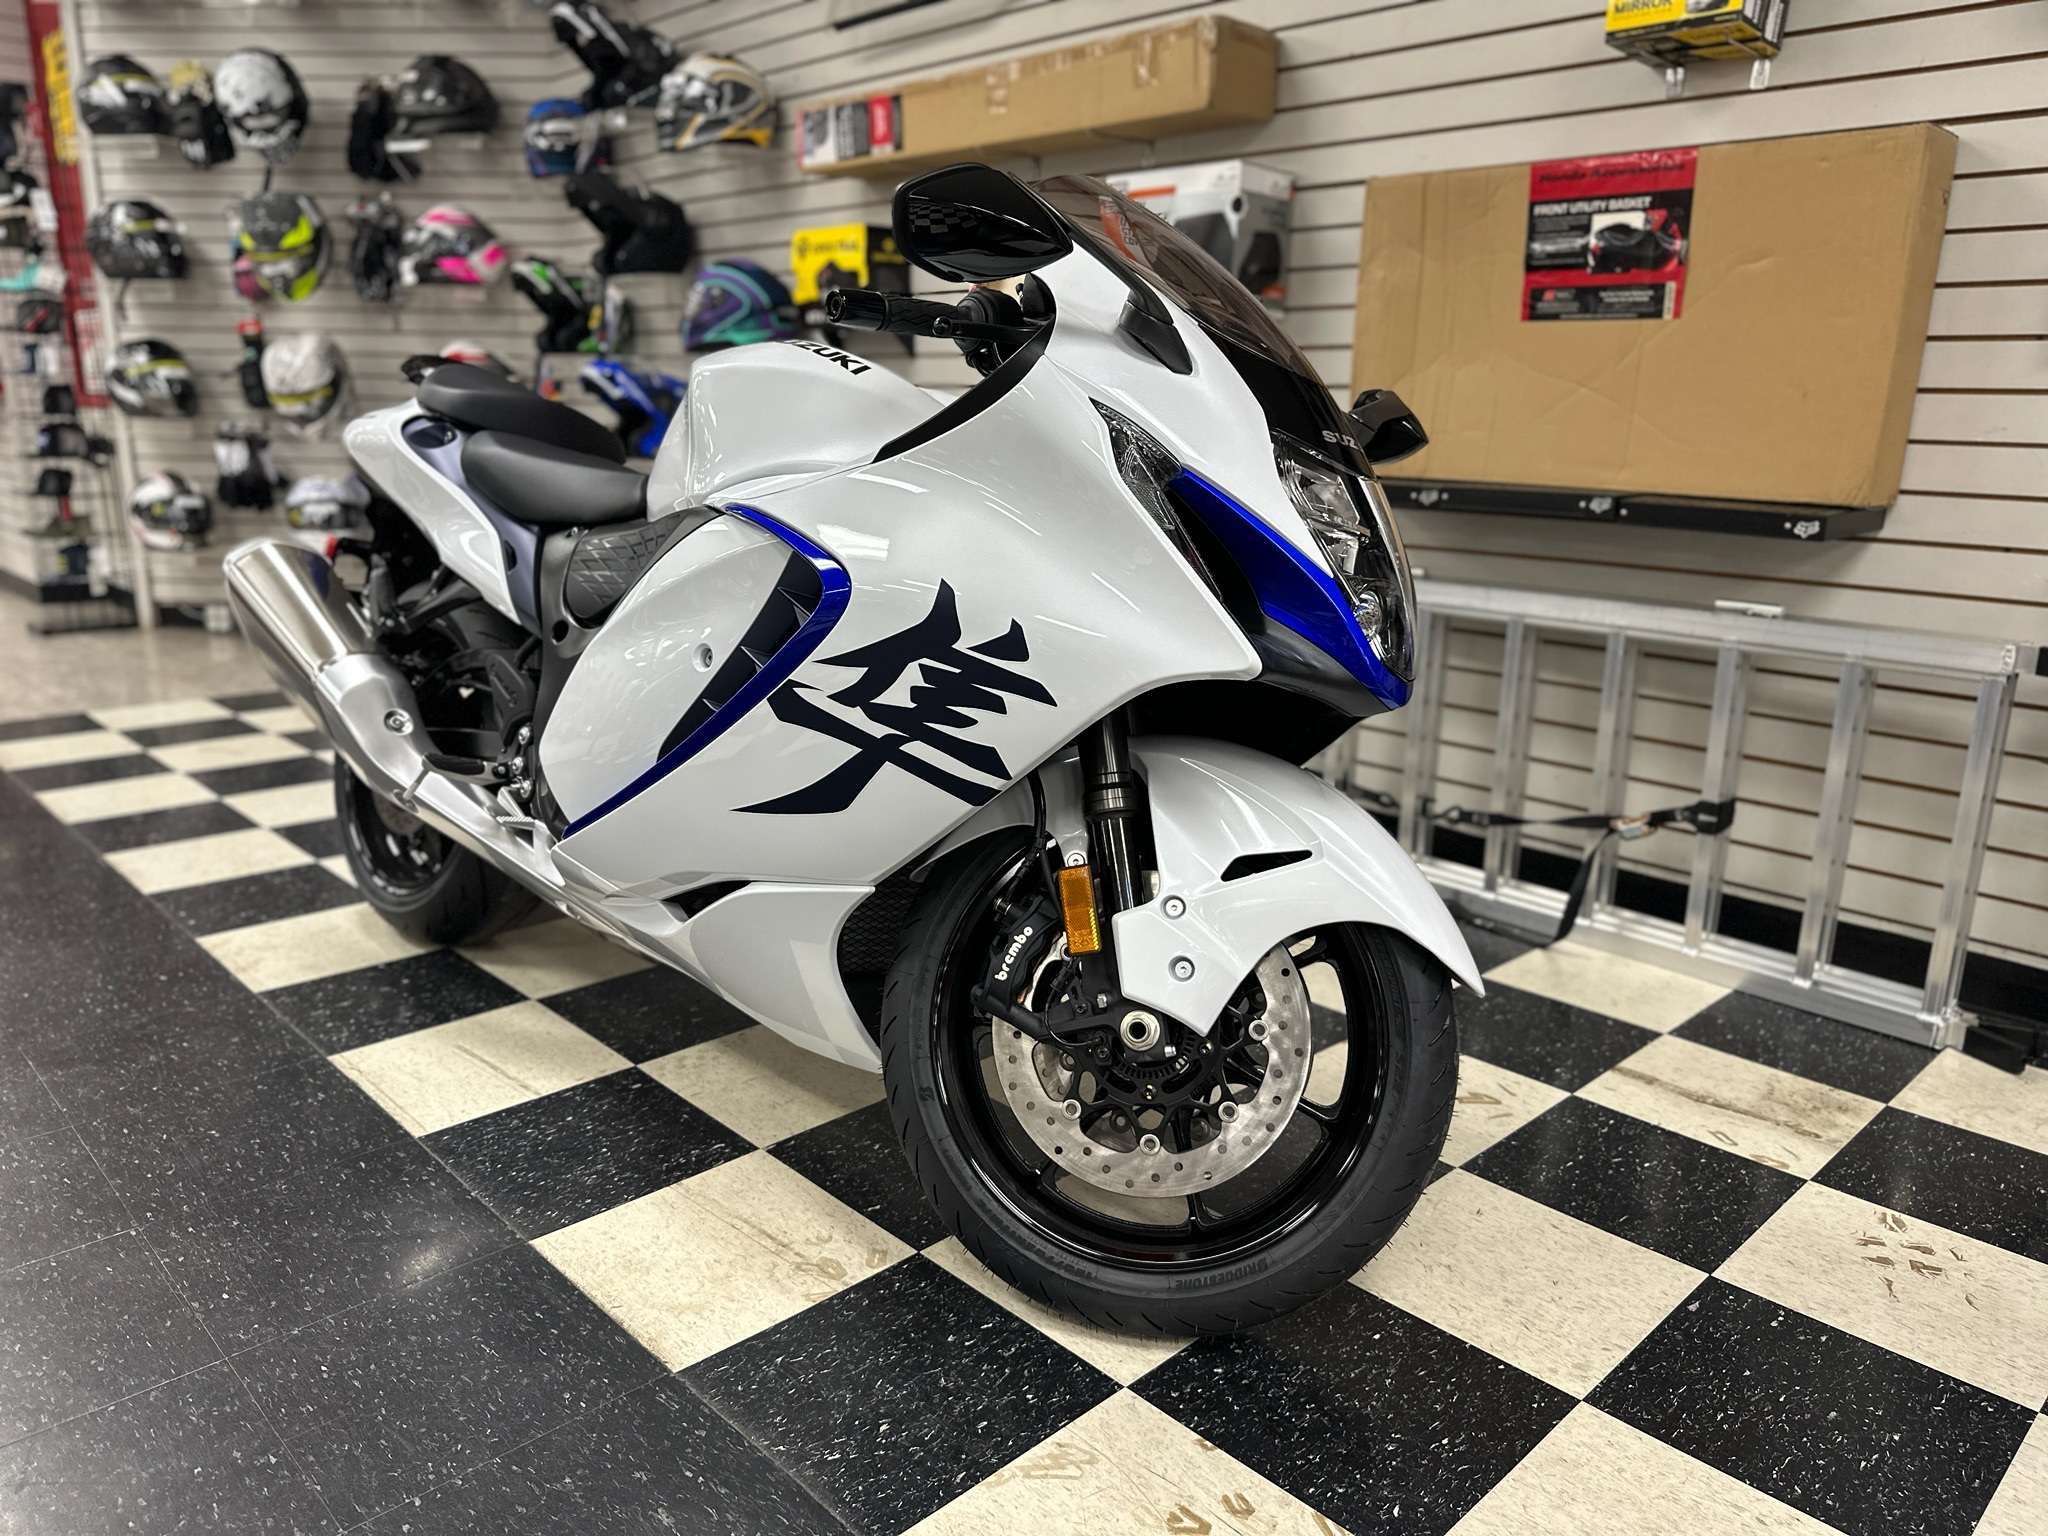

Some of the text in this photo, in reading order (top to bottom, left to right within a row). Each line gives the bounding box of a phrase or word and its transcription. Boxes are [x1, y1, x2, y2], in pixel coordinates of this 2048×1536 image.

[1533, 196, 1652, 216] FRONT UTILITY BASKET
[730, 578, 1058, 814] 隼
[995, 926, 1033, 981] brembo
[1175, 1257, 1268, 1290] BRIDGESTONE
